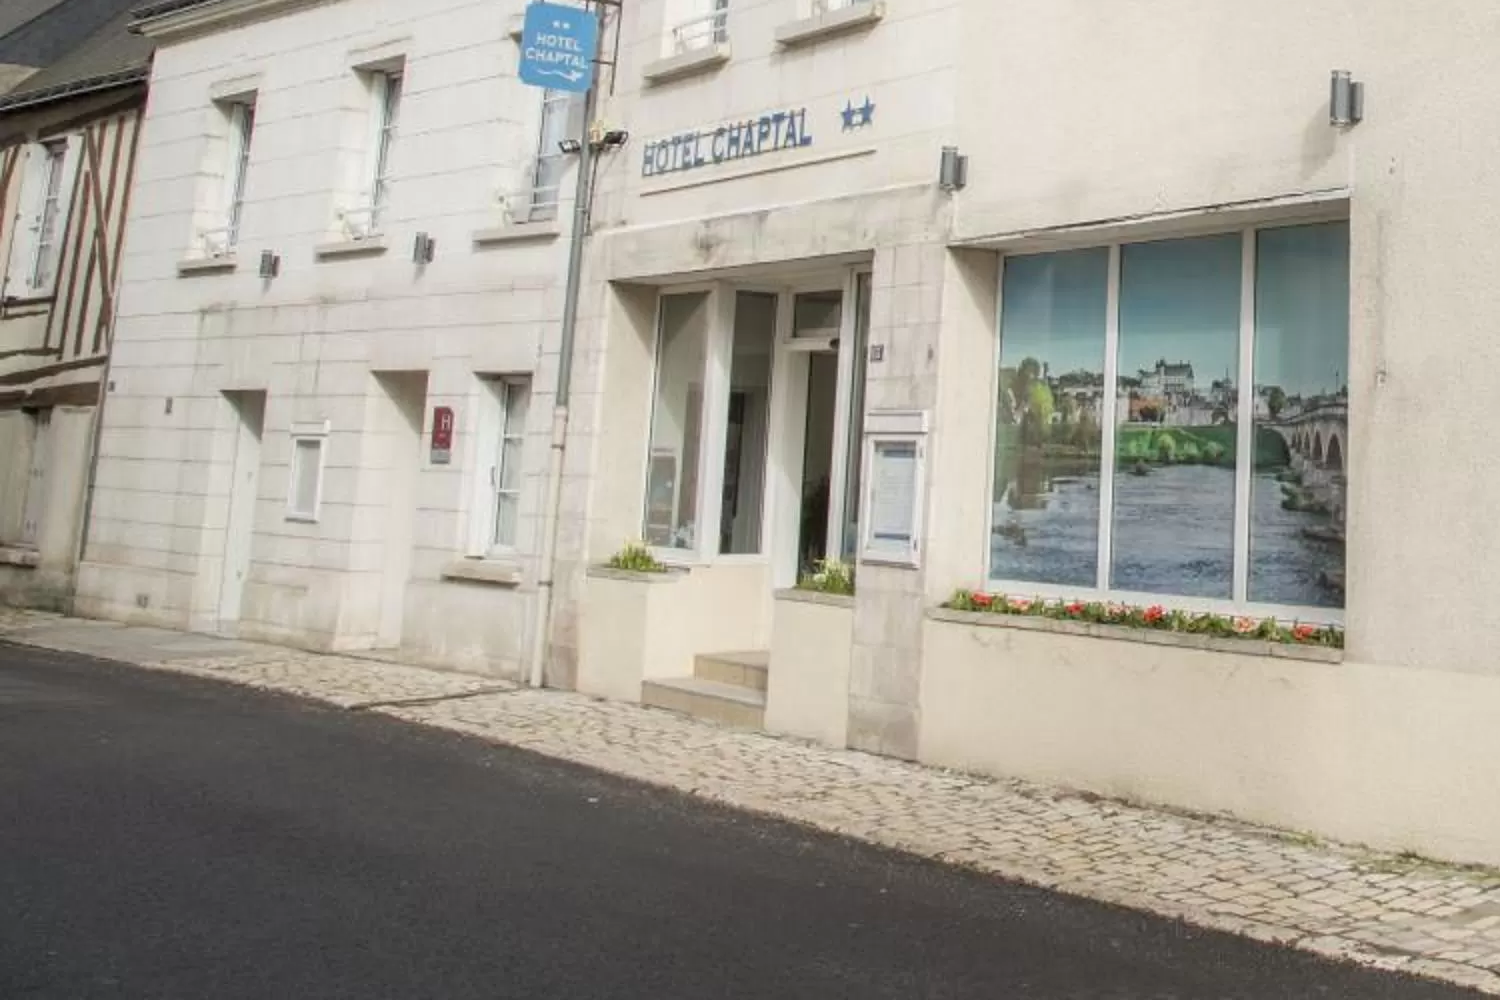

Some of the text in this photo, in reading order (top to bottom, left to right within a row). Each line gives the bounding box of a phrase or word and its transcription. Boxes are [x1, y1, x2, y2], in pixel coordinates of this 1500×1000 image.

[537, 31, 582, 52] HOTEL
[525, 46, 589, 70] CHAPTAL
[641, 107, 813, 177] HOTEL CHAPTAL
